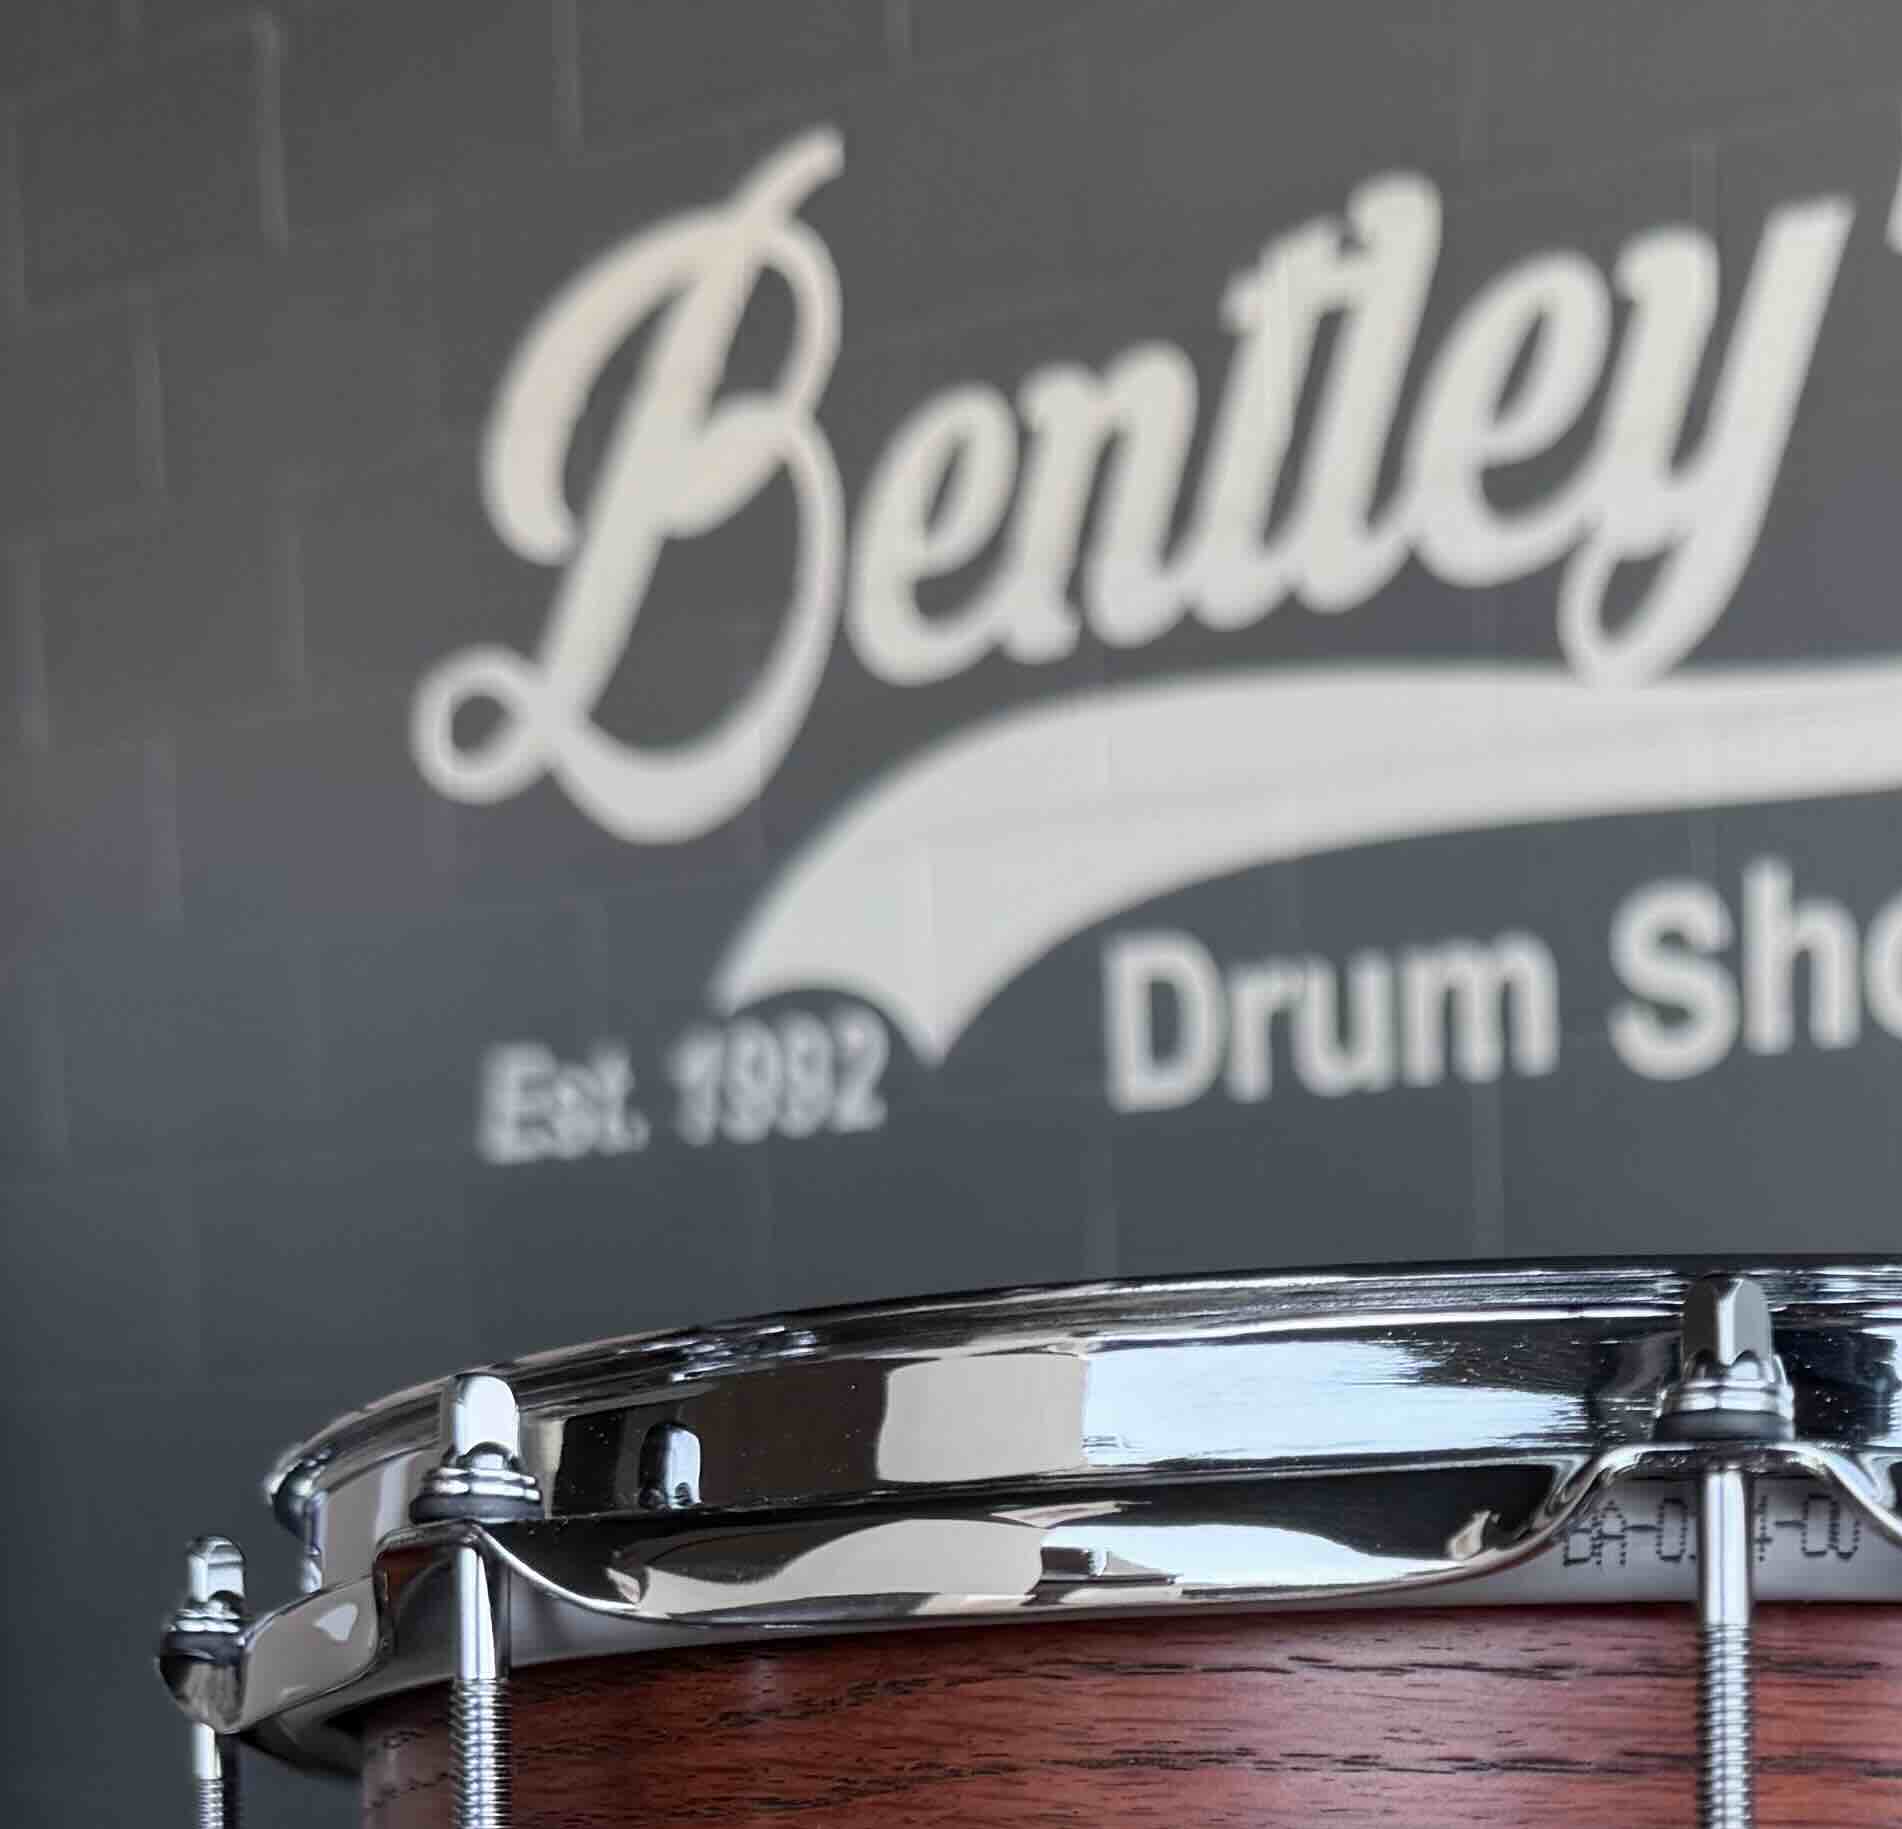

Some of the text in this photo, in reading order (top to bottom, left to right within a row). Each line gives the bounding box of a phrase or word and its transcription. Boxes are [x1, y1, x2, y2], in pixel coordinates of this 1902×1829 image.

[476, 1007, 890, 1164] Est. 1992
[1102, 930, 1560, 1112] Drum
